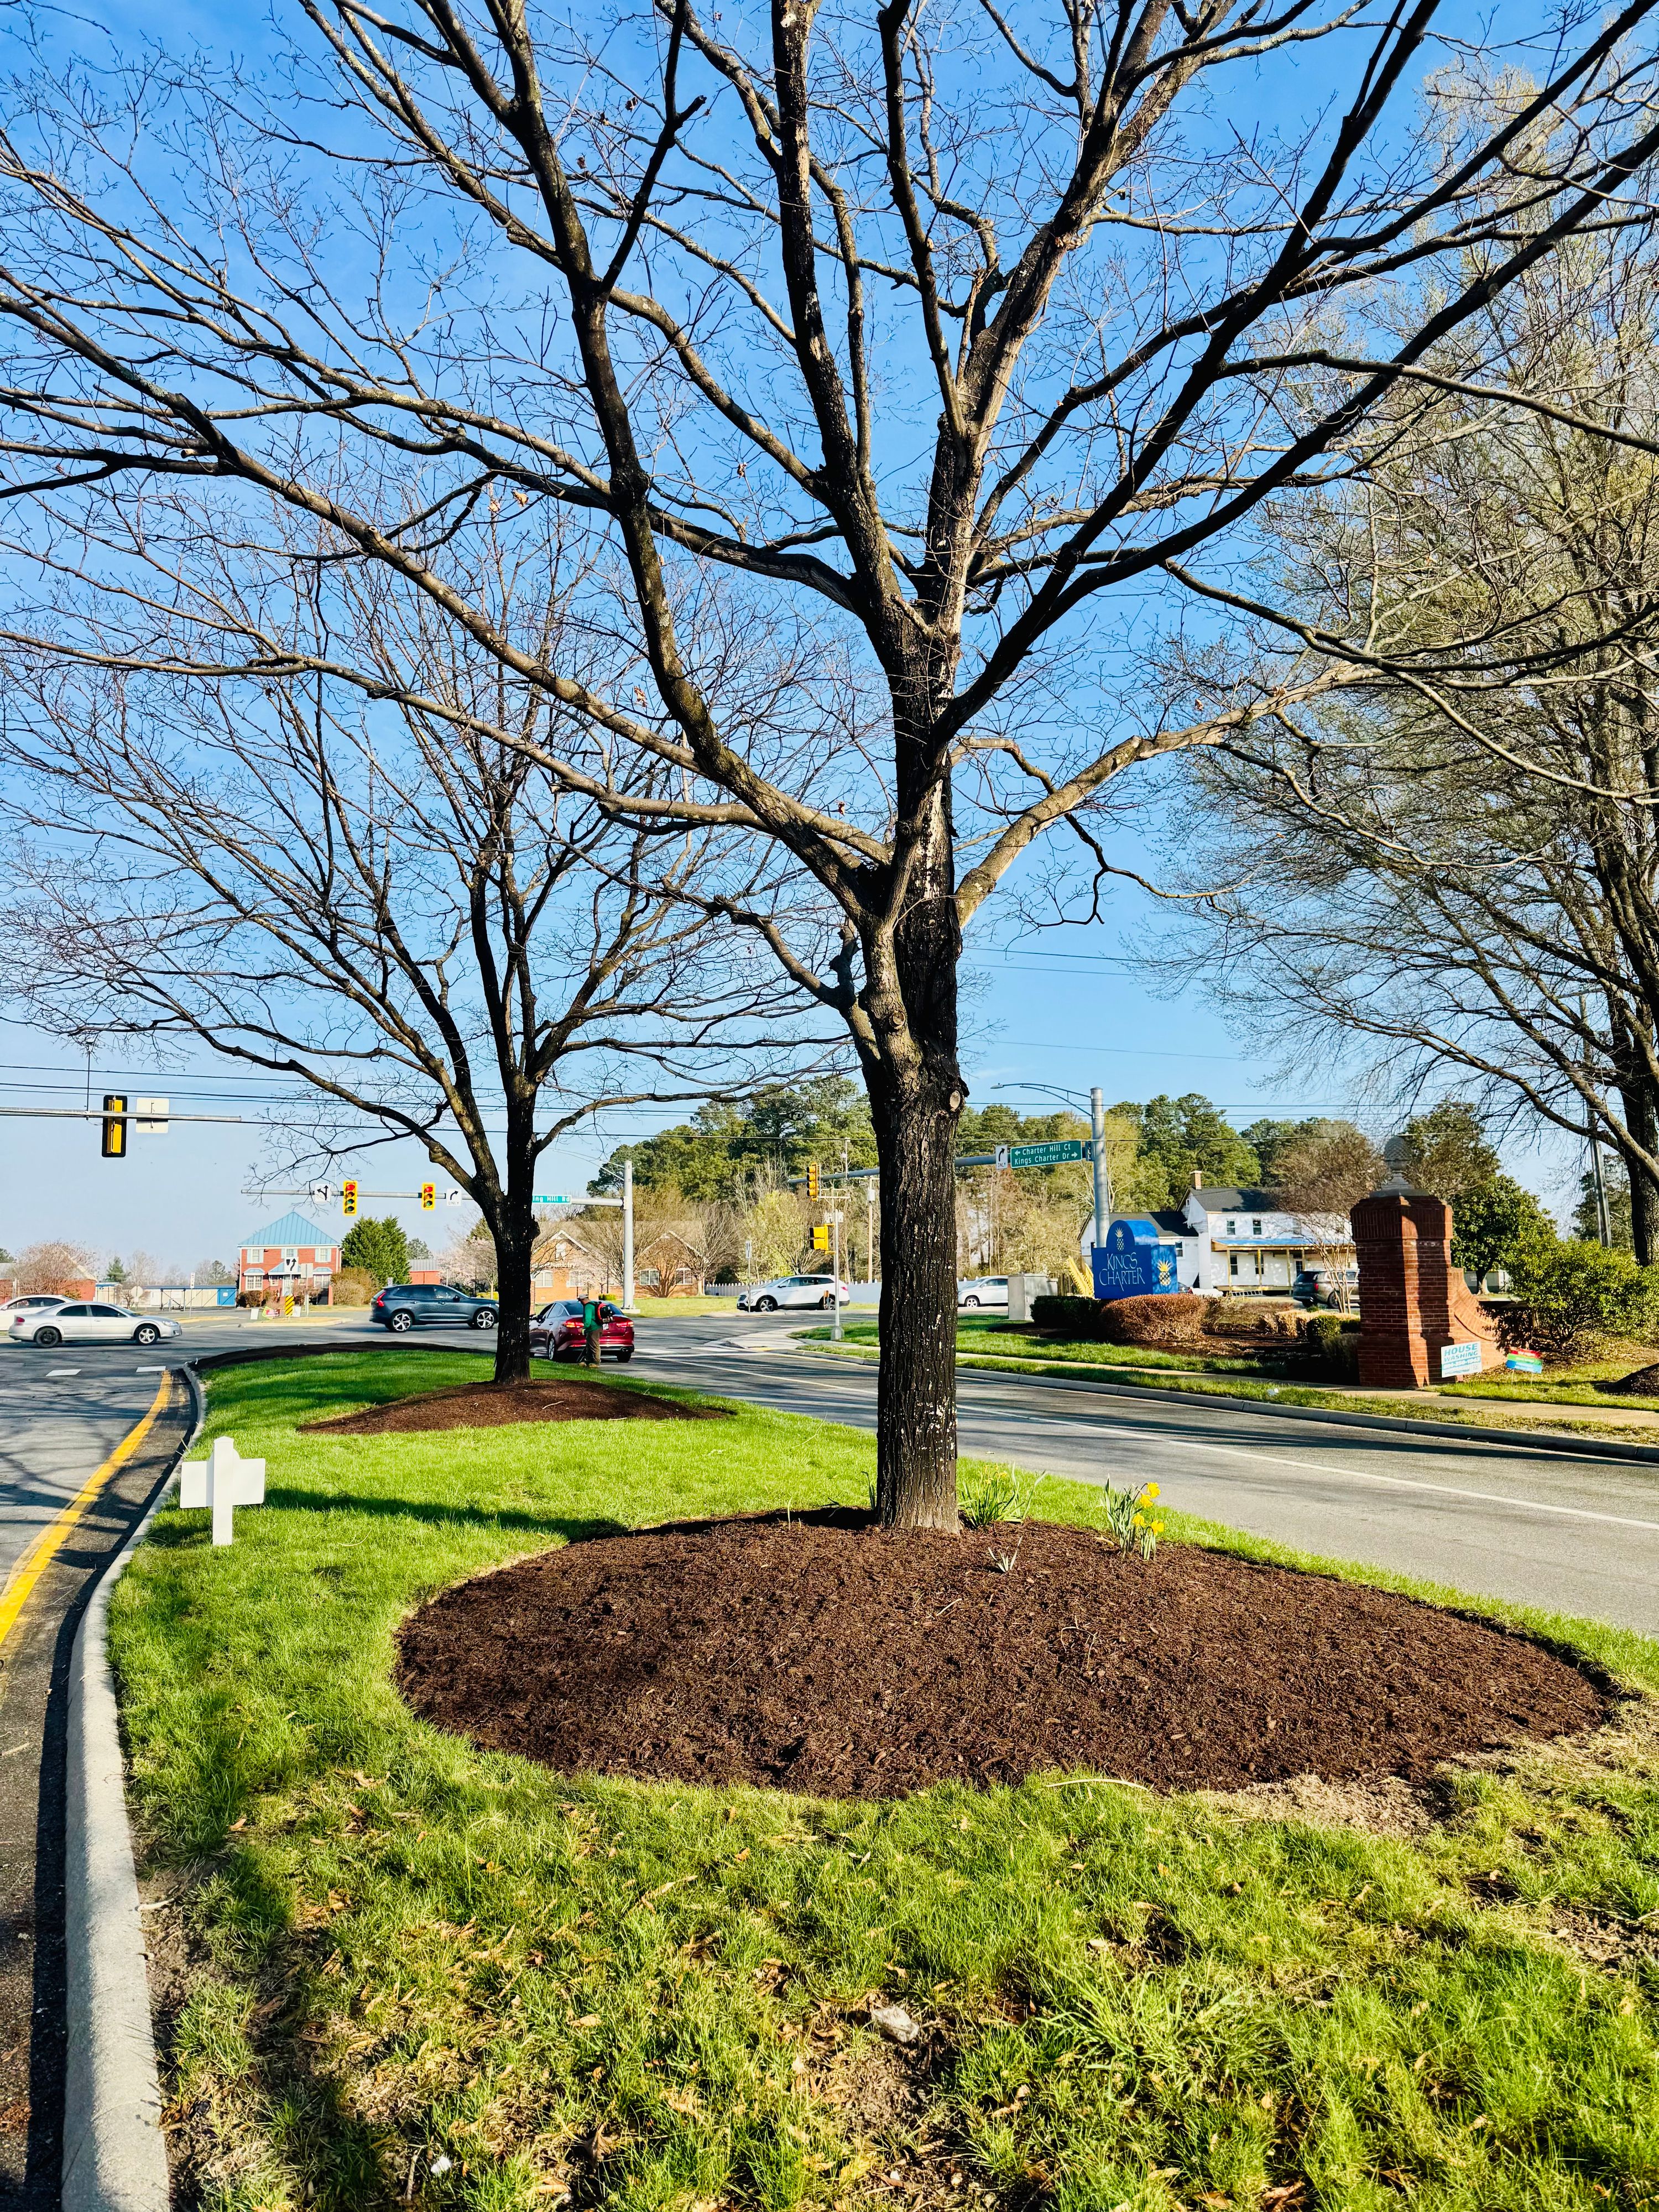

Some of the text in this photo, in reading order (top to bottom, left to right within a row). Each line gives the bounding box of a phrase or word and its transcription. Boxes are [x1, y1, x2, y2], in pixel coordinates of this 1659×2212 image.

[1035, 1154, 1059, 1162] Charter
[1107, 1252, 1138, 1271] KINGS
[1099, 1267, 1146, 1291] CHARTER
[1444, 1343, 1478, 1357] HOUSE
[1444, 1351, 1478, 1362] WASHING
